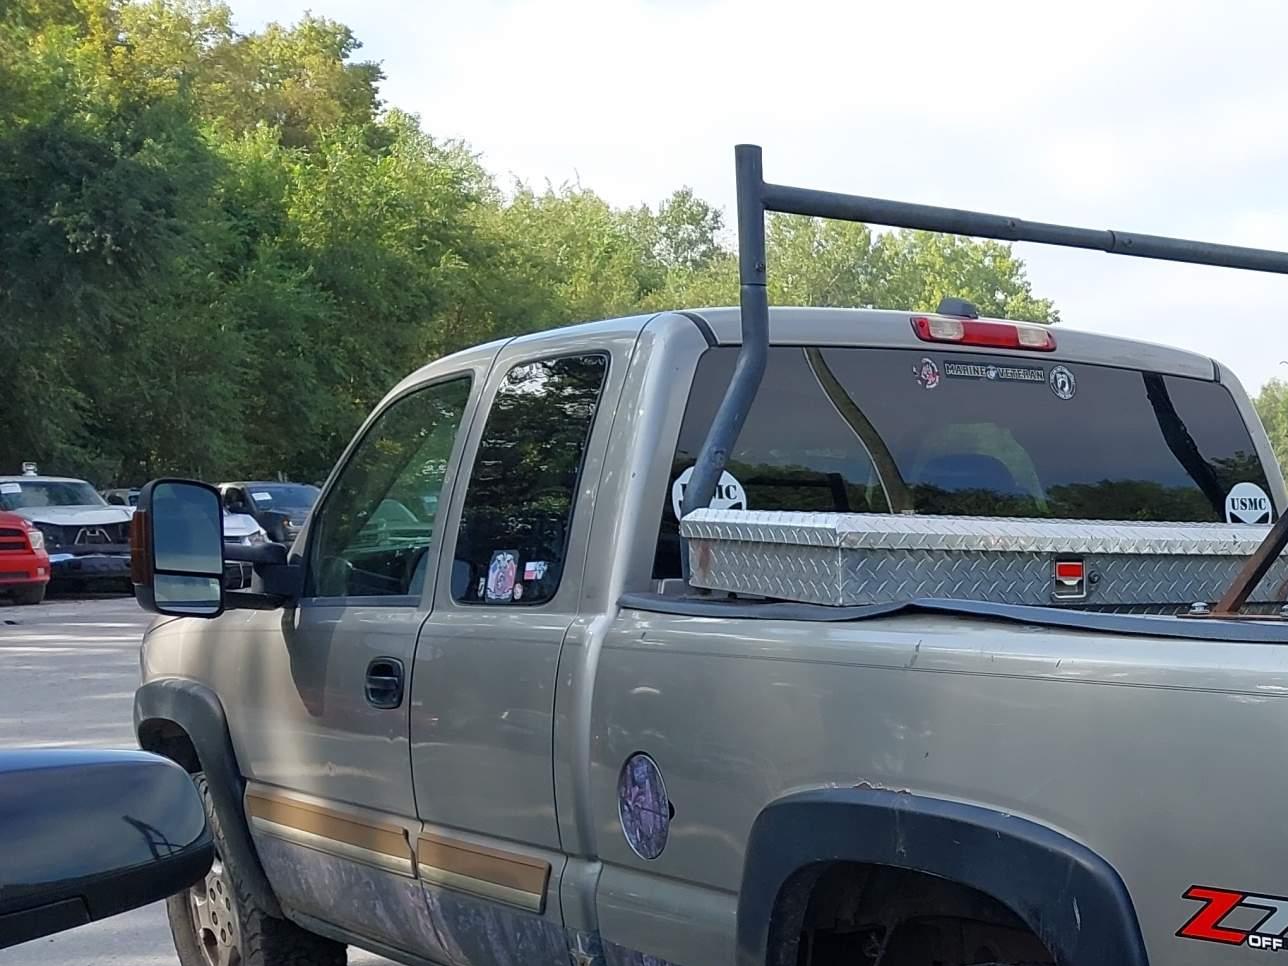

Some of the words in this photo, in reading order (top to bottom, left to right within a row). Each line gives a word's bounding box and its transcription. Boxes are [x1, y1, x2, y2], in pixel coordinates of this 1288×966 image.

[944, 363, 986, 377] MARINE
[997, 367, 1045, 381] VETERAN
[1230, 497, 1267, 511] USMC
[1248, 934, 1284, 951] OFF
